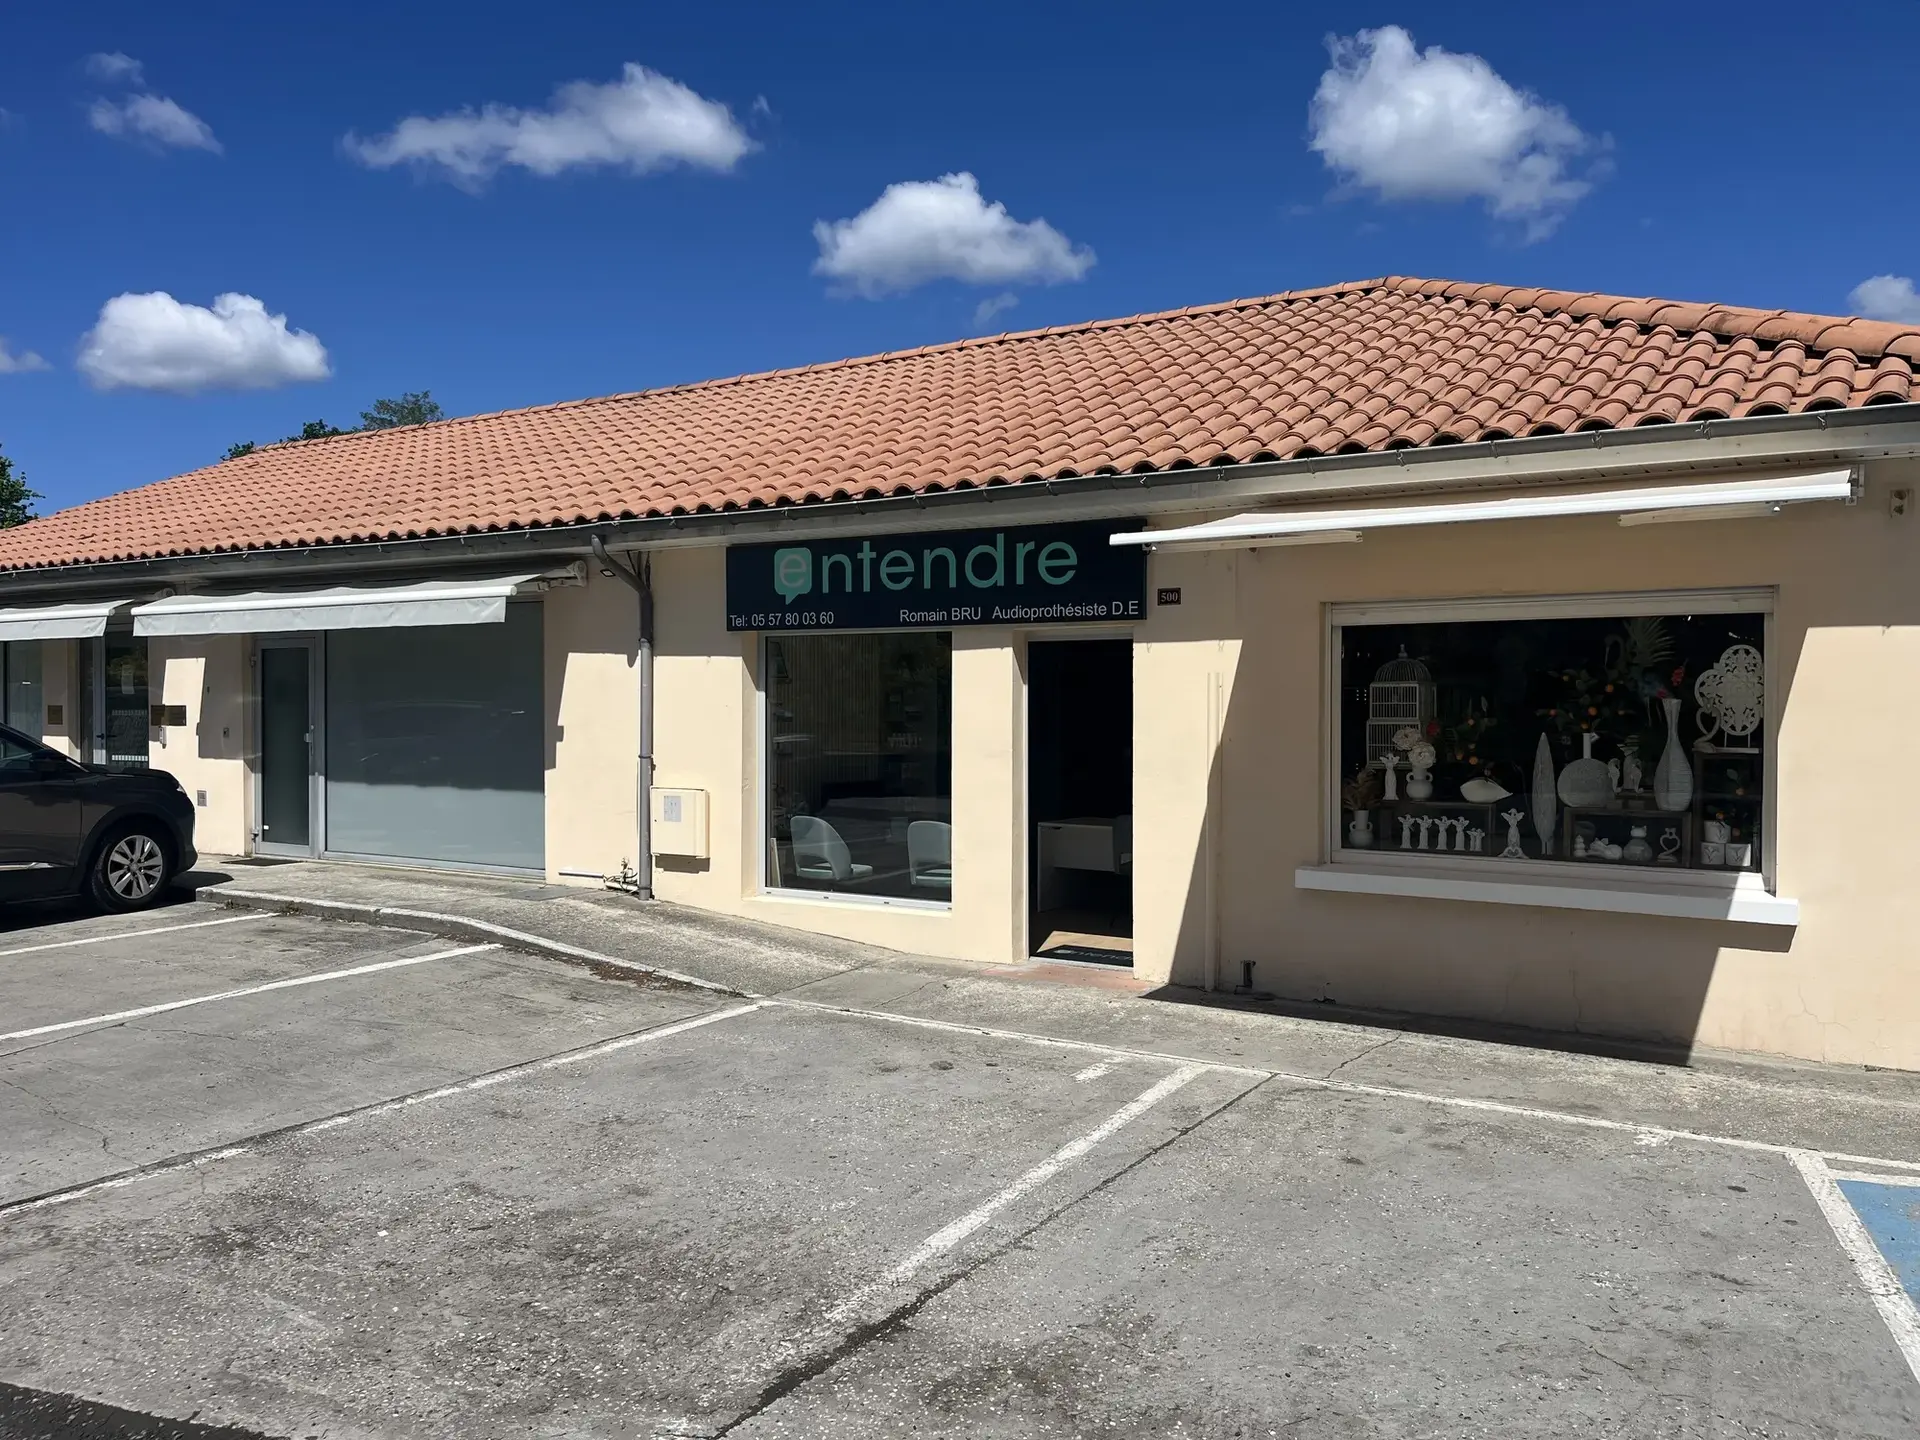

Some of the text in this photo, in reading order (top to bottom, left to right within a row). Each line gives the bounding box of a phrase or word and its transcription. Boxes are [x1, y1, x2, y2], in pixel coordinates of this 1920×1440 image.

[779, 533, 1078, 594] entendre
[1161, 592, 1178, 602] 500
[900, 607, 981, 622] Romain BRU
[992, 600, 1139, 620] Audioprothésiste D.E
[730, 611, 834, 627] Tel: 05 57 80 03 60
